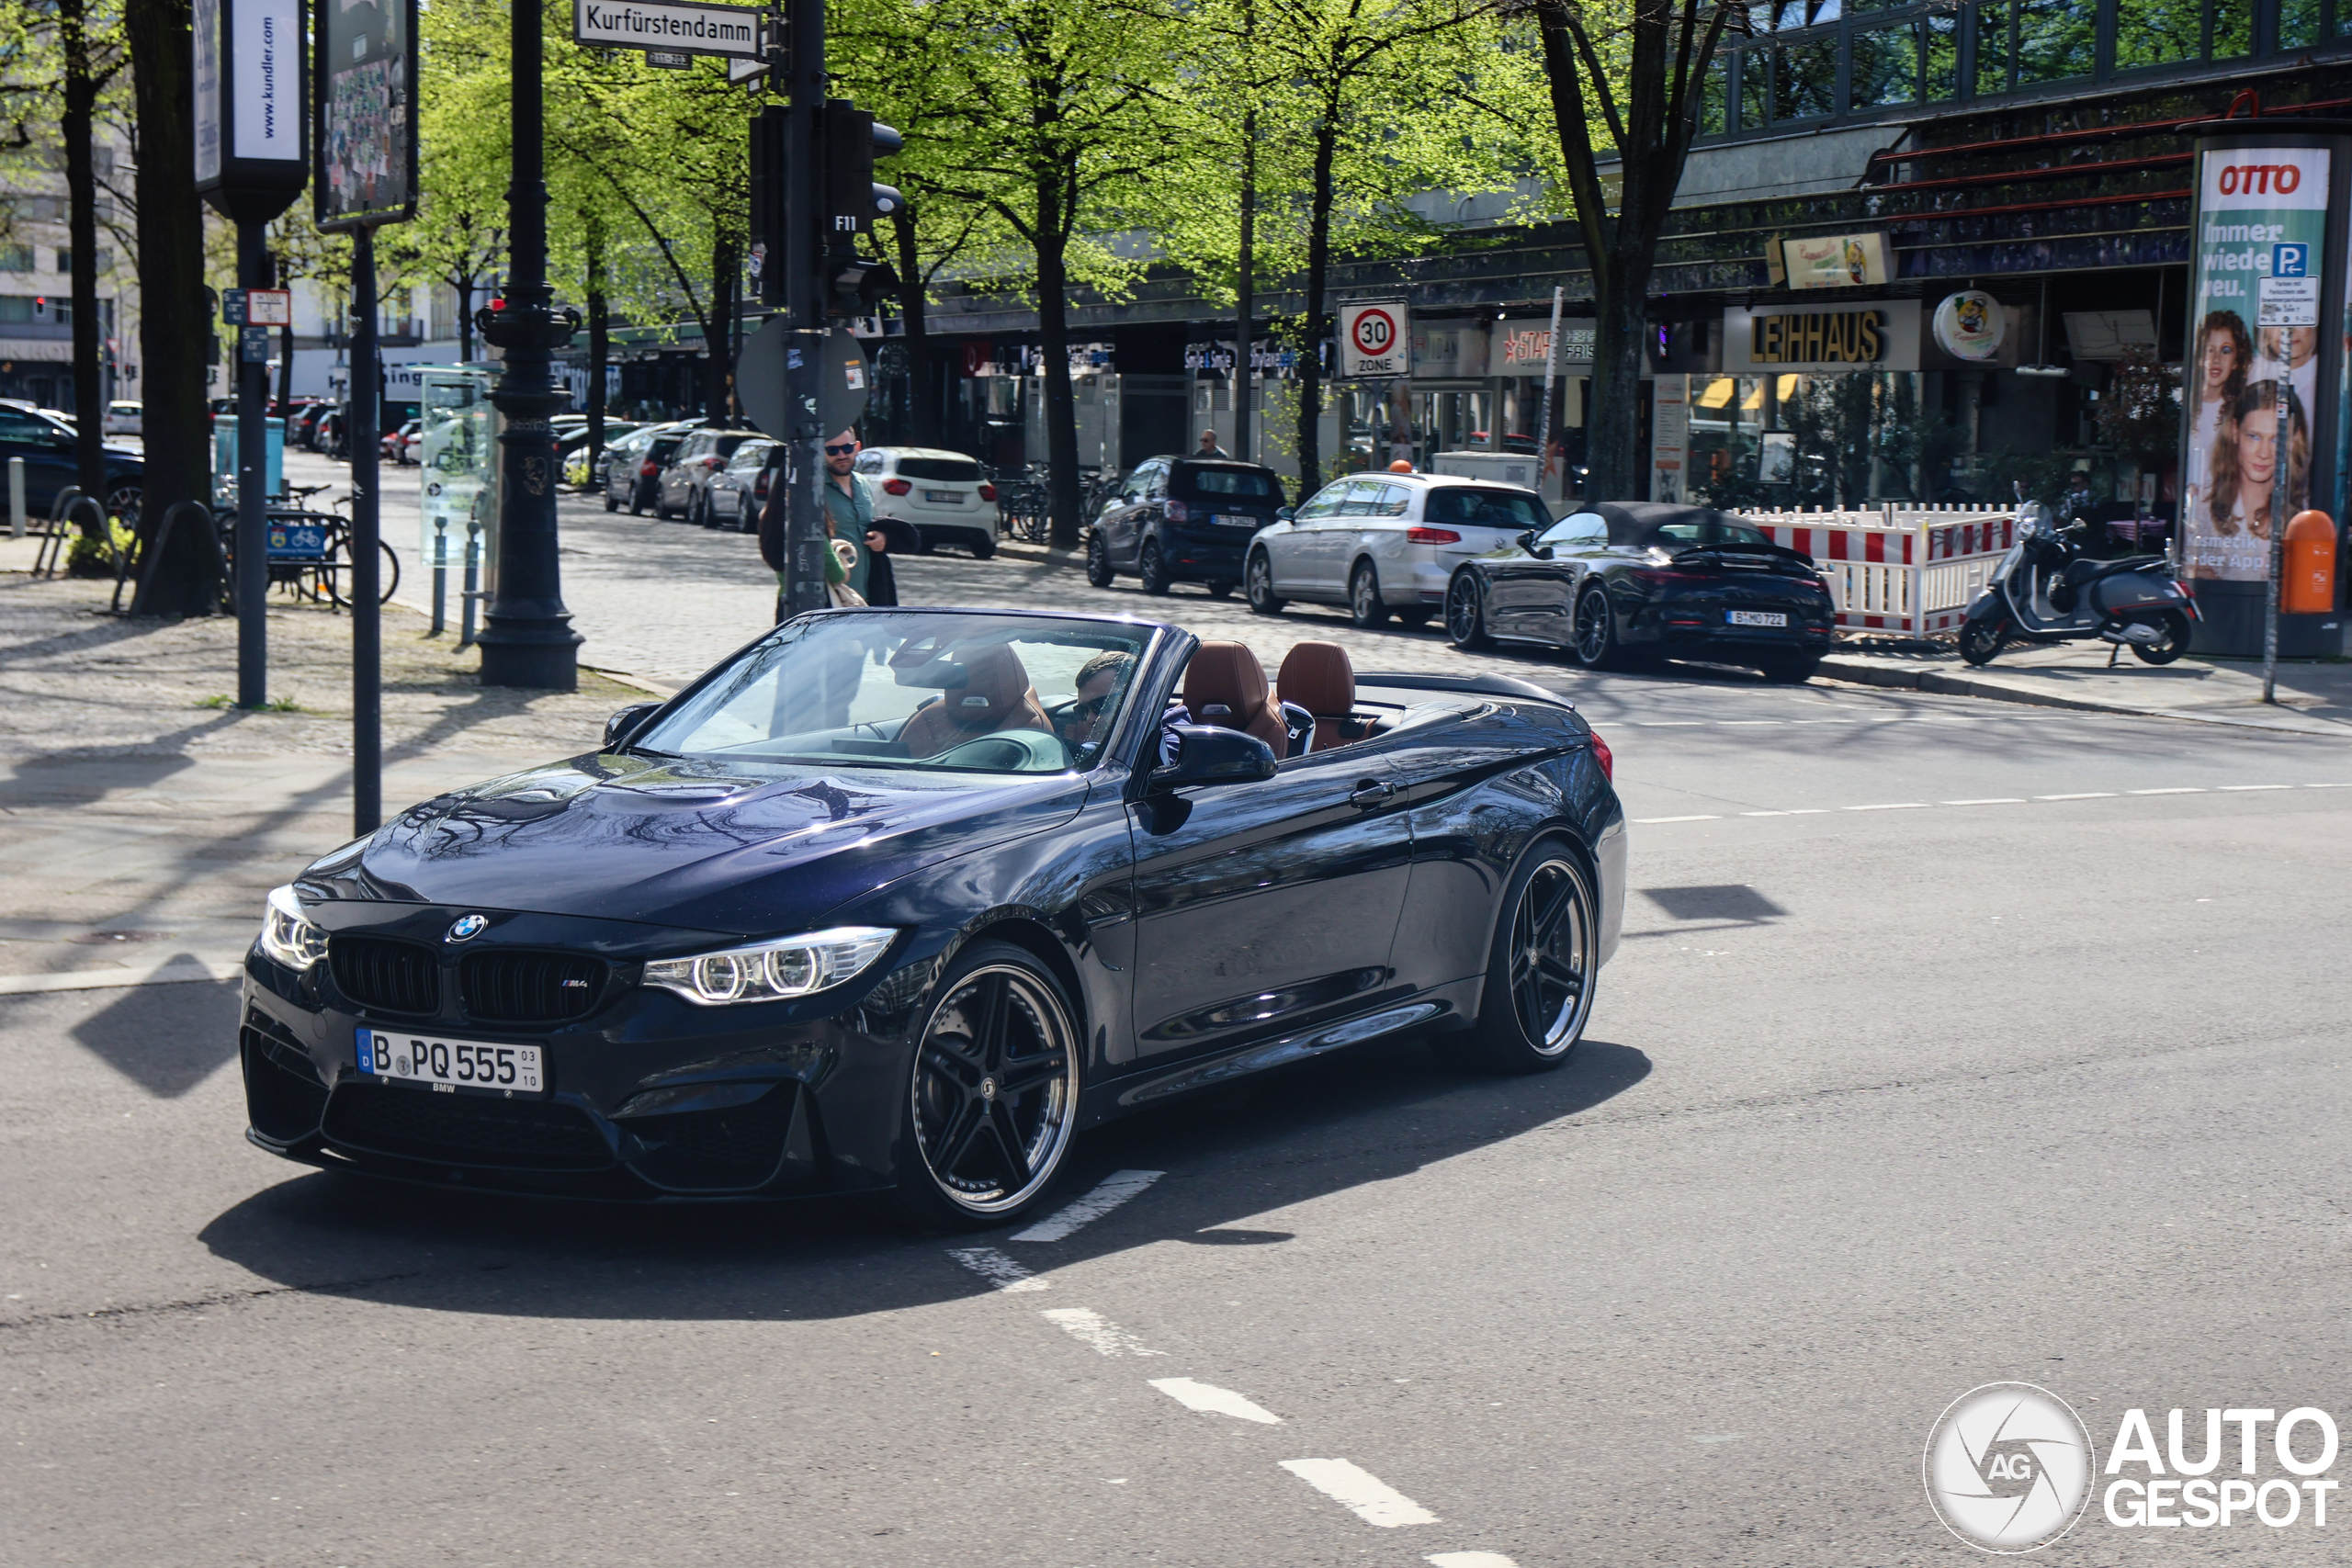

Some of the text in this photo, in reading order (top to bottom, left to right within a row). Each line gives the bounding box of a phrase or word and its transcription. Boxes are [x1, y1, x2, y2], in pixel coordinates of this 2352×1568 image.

[587, 6, 751, 42] Kurfürstendamm
[261, 17, 274, 139] www.kundler.com
[2219, 164, 2301, 196] OTTO
[835, 216, 856, 231] F11
[2204, 221, 2284, 243] Immer
[2203, 247, 2271, 271] wiede
[1361, 321, 1386, 344] 30
[1749, 310, 1879, 363] LEIHHAUS
[1359, 358, 1392, 371] ZONE
[1764, 614, 1782, 625] 722
[362, 1034, 516, 1085] D B PQ 555
[521, 1051, 536, 1062] 03
[433, 1083, 456, 1093] BMW
[523, 1076, 537, 1087] 10
